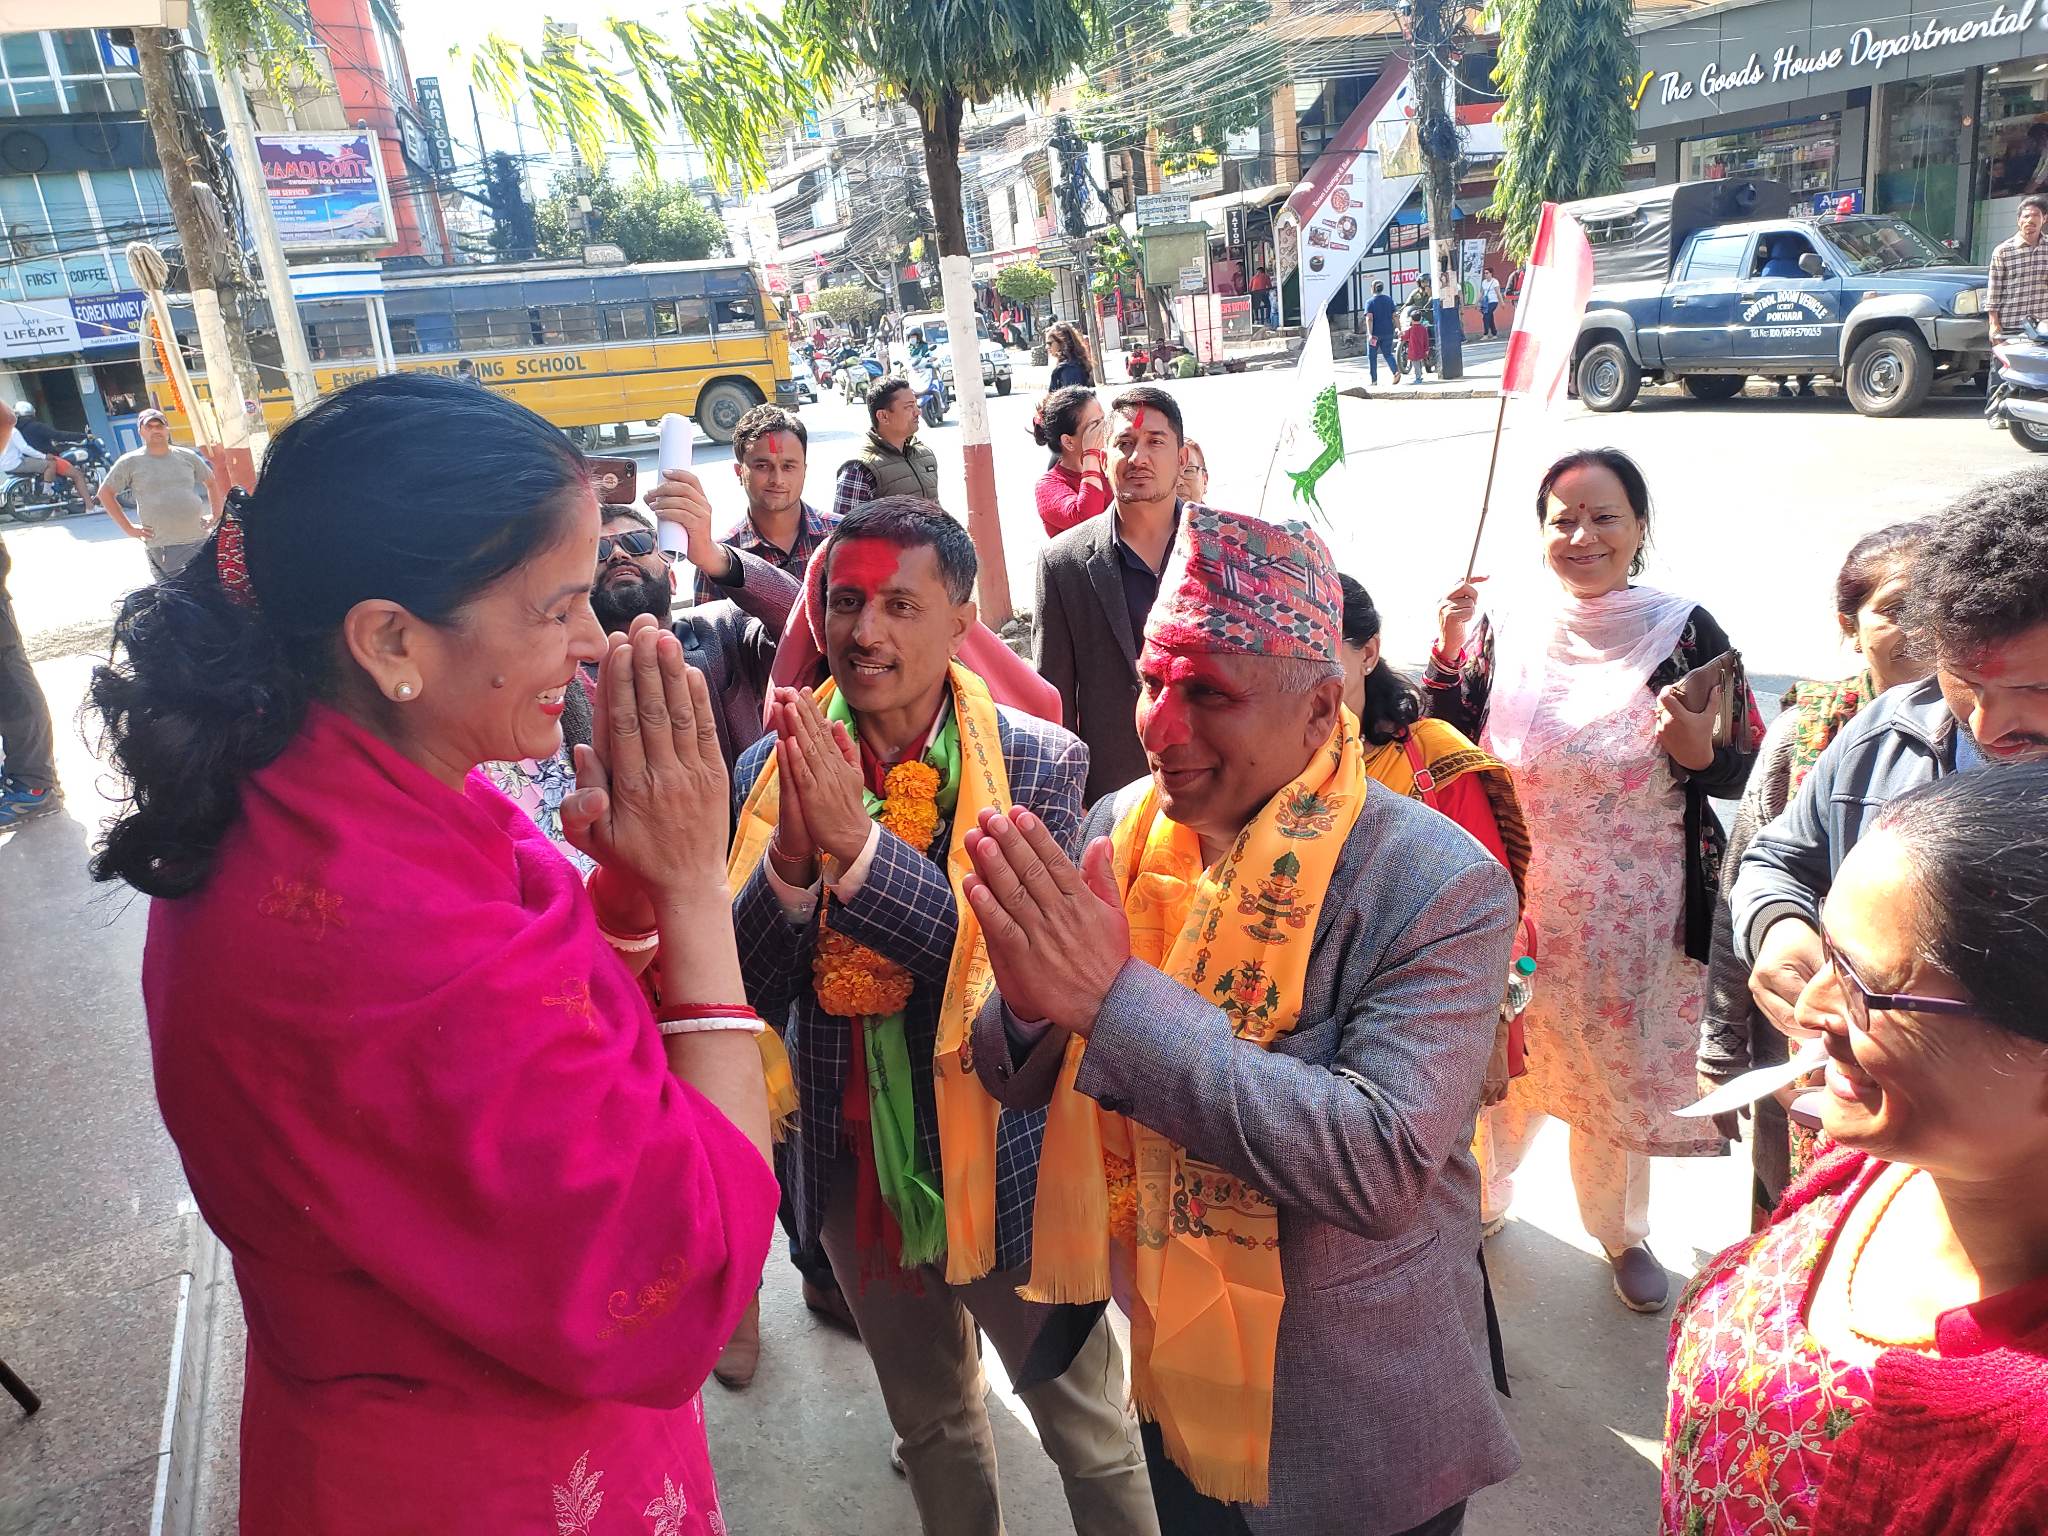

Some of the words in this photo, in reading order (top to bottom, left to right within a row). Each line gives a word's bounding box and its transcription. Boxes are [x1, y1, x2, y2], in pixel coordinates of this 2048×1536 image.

[1659, 71, 1692, 105] The
[1699, 53, 1764, 97] Goods
[1772, 44, 1843, 83] House
[1850, 0, 2034, 71] Departmental
[424, 89, 452, 169] MARIGOLD
[318, 160, 369, 178] POINT
[1820, 192, 1855, 208] Anl
[1231, 211, 1240, 245] TATTOO
[25, 272, 58, 287] FIRST
[70, 268, 108, 283] COFFEE
[75, 303, 108, 321] FOREX
[106, 300, 140, 319] MONEY
[1743, 294, 1777, 322] CONTROL
[1777, 290, 1801, 303] ROOM
[1798, 292, 1828, 320] VEHICLE
[1766, 311, 1802, 322] POKHARA
[4, 325, 66, 340] LIFEART
[516, 355, 588, 376] SCHOOL
